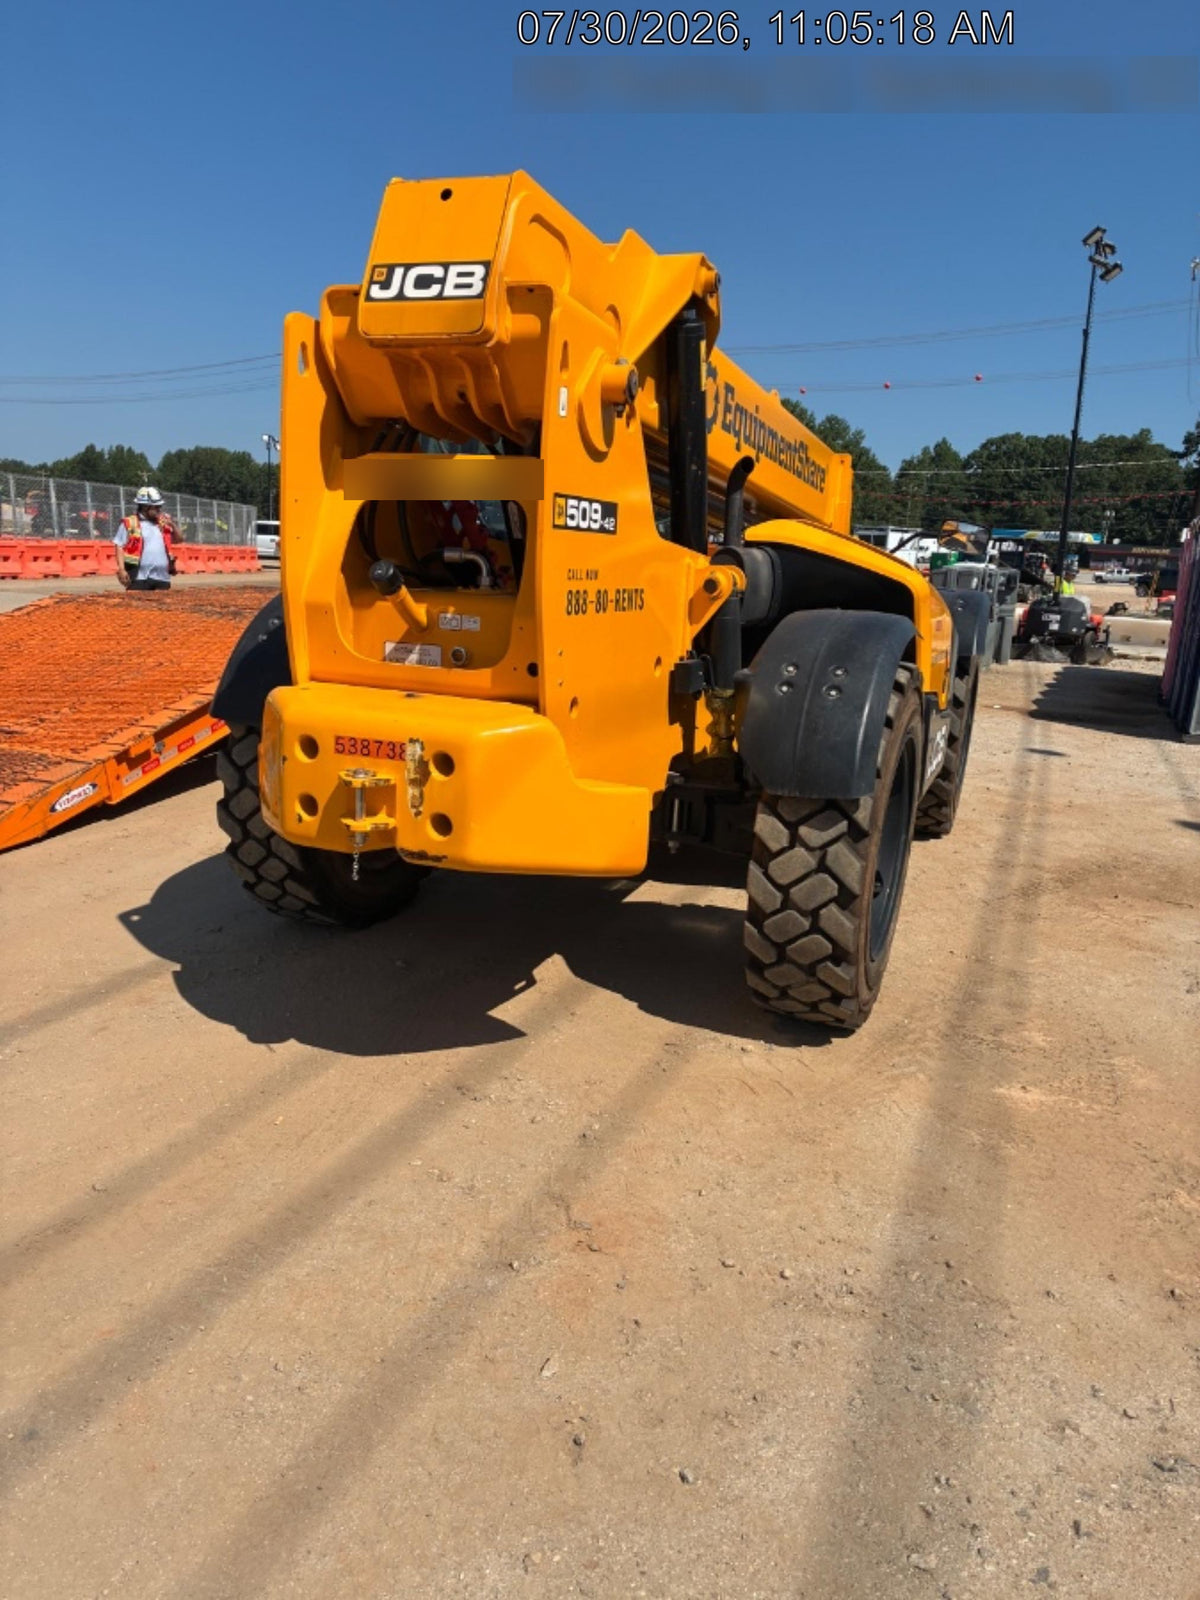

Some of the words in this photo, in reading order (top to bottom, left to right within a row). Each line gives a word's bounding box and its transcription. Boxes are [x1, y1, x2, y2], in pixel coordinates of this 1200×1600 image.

[369, 264, 486, 299] JCB
[721, 381, 826, 494] EquipmentShare
[567, 568, 583, 581] CALL
[586, 568, 599, 580] NOW
[566, 587, 645, 616] 888-80-RENTS
